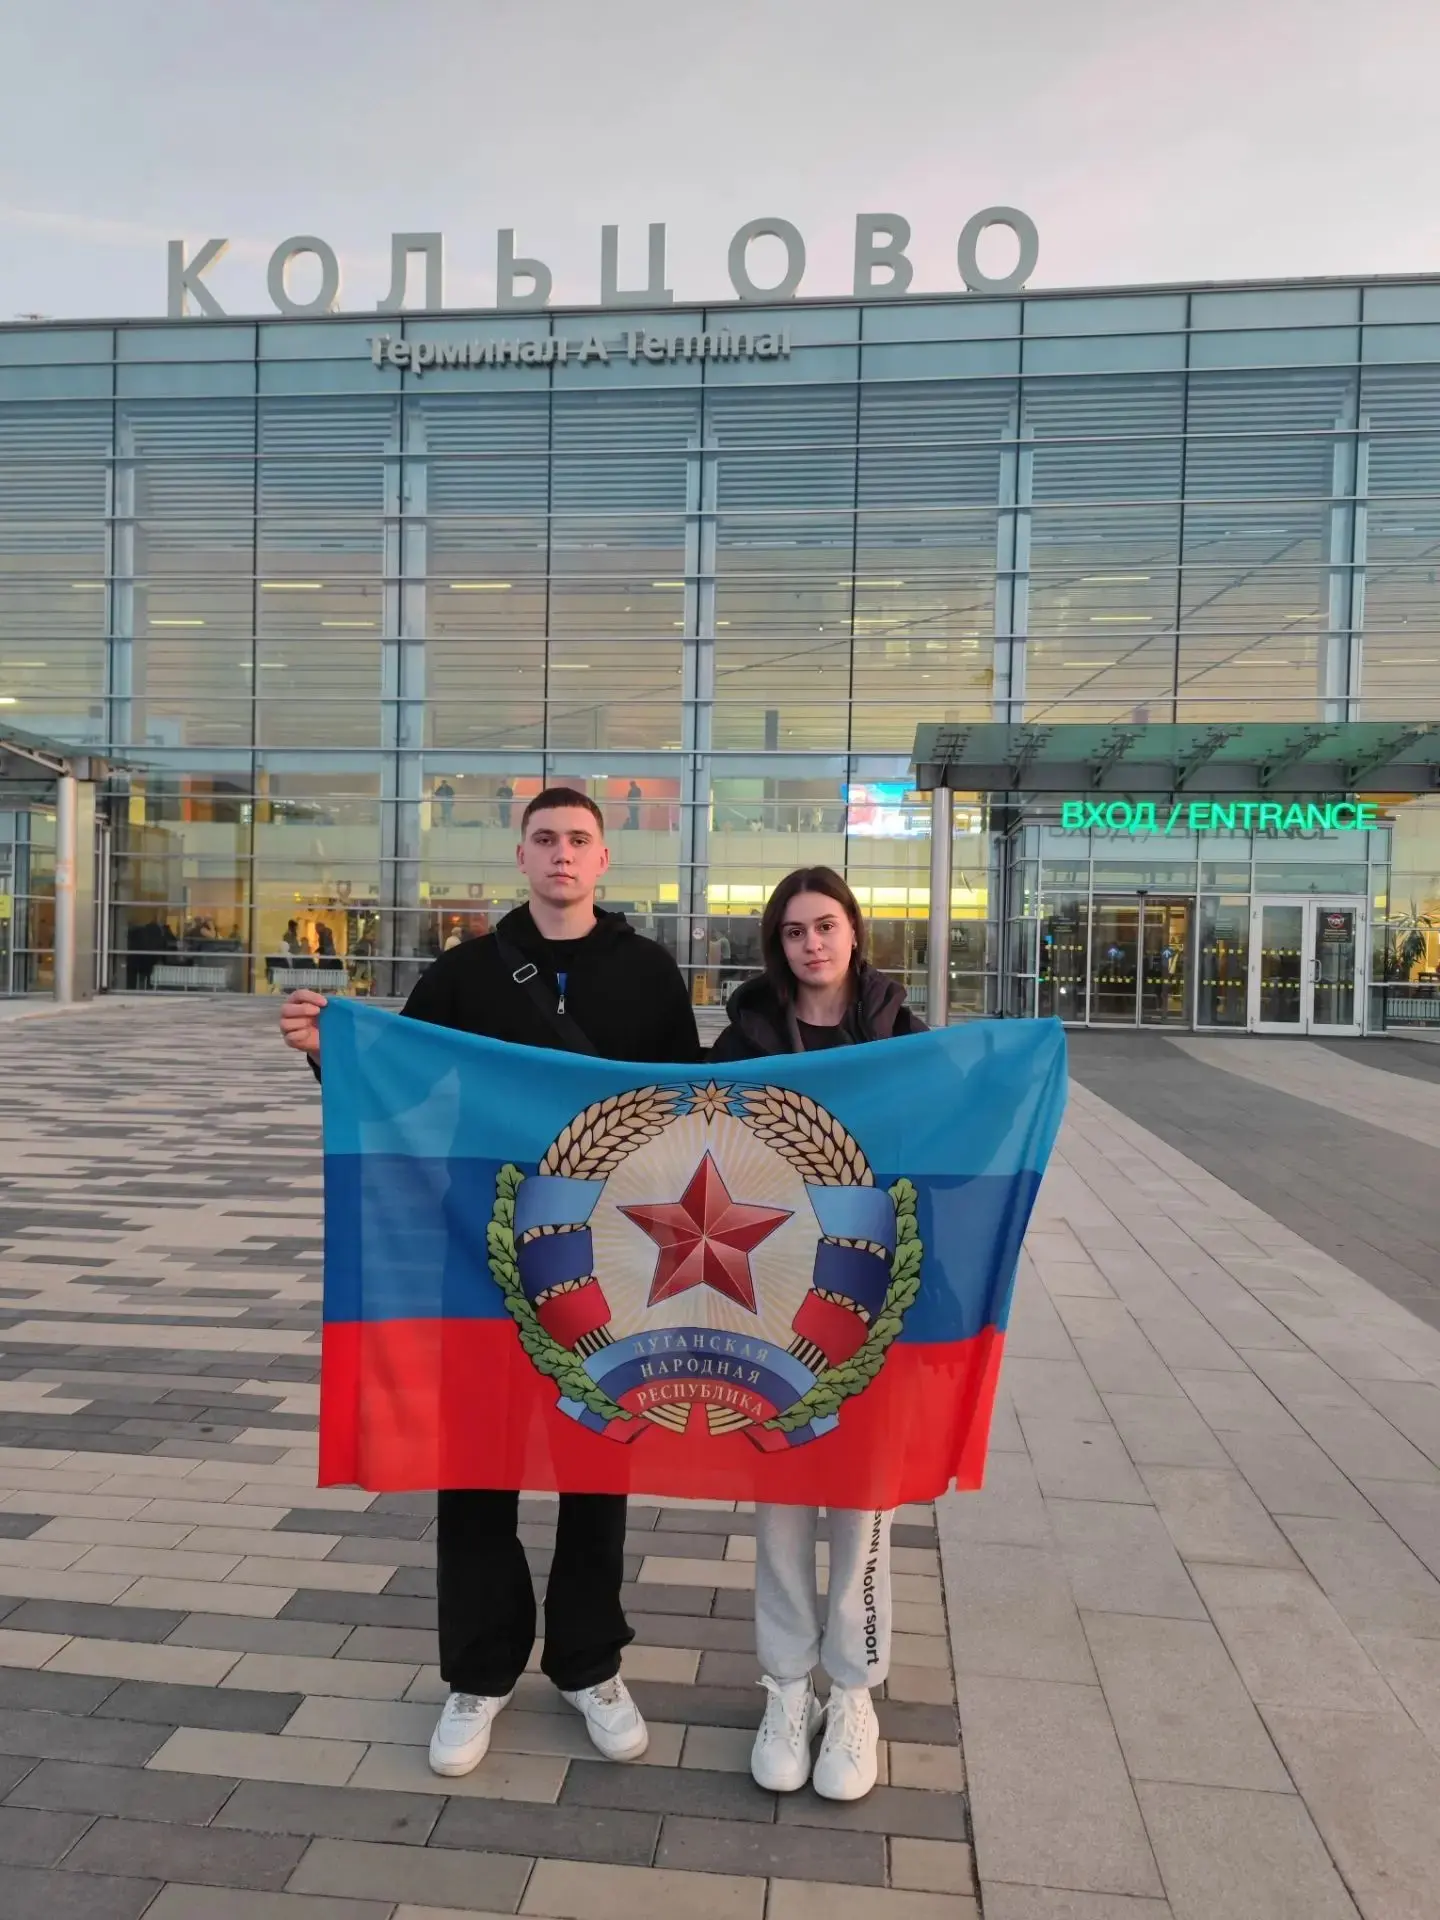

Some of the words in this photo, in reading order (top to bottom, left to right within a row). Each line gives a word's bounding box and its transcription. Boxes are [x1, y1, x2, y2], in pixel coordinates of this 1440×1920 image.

[167, 206, 1040, 318] КОЛЬЦОВО
[369, 332, 567, 373] Терминал
[624, 326, 791, 360] Terminal
[1061, 801, 1158, 834] ВХОД
[1164, 802, 1183, 834] /
[1188, 802, 1379, 831] ENTRANCE
[633, 1334, 769, 1361] ЛУГАНСКАЯ
[640, 1358, 761, 1384] НАРОДНАЯ
[636, 1383, 763, 1416] РЕСПУБЛИКА
[863, 1558, 880, 1666] Motorsport
